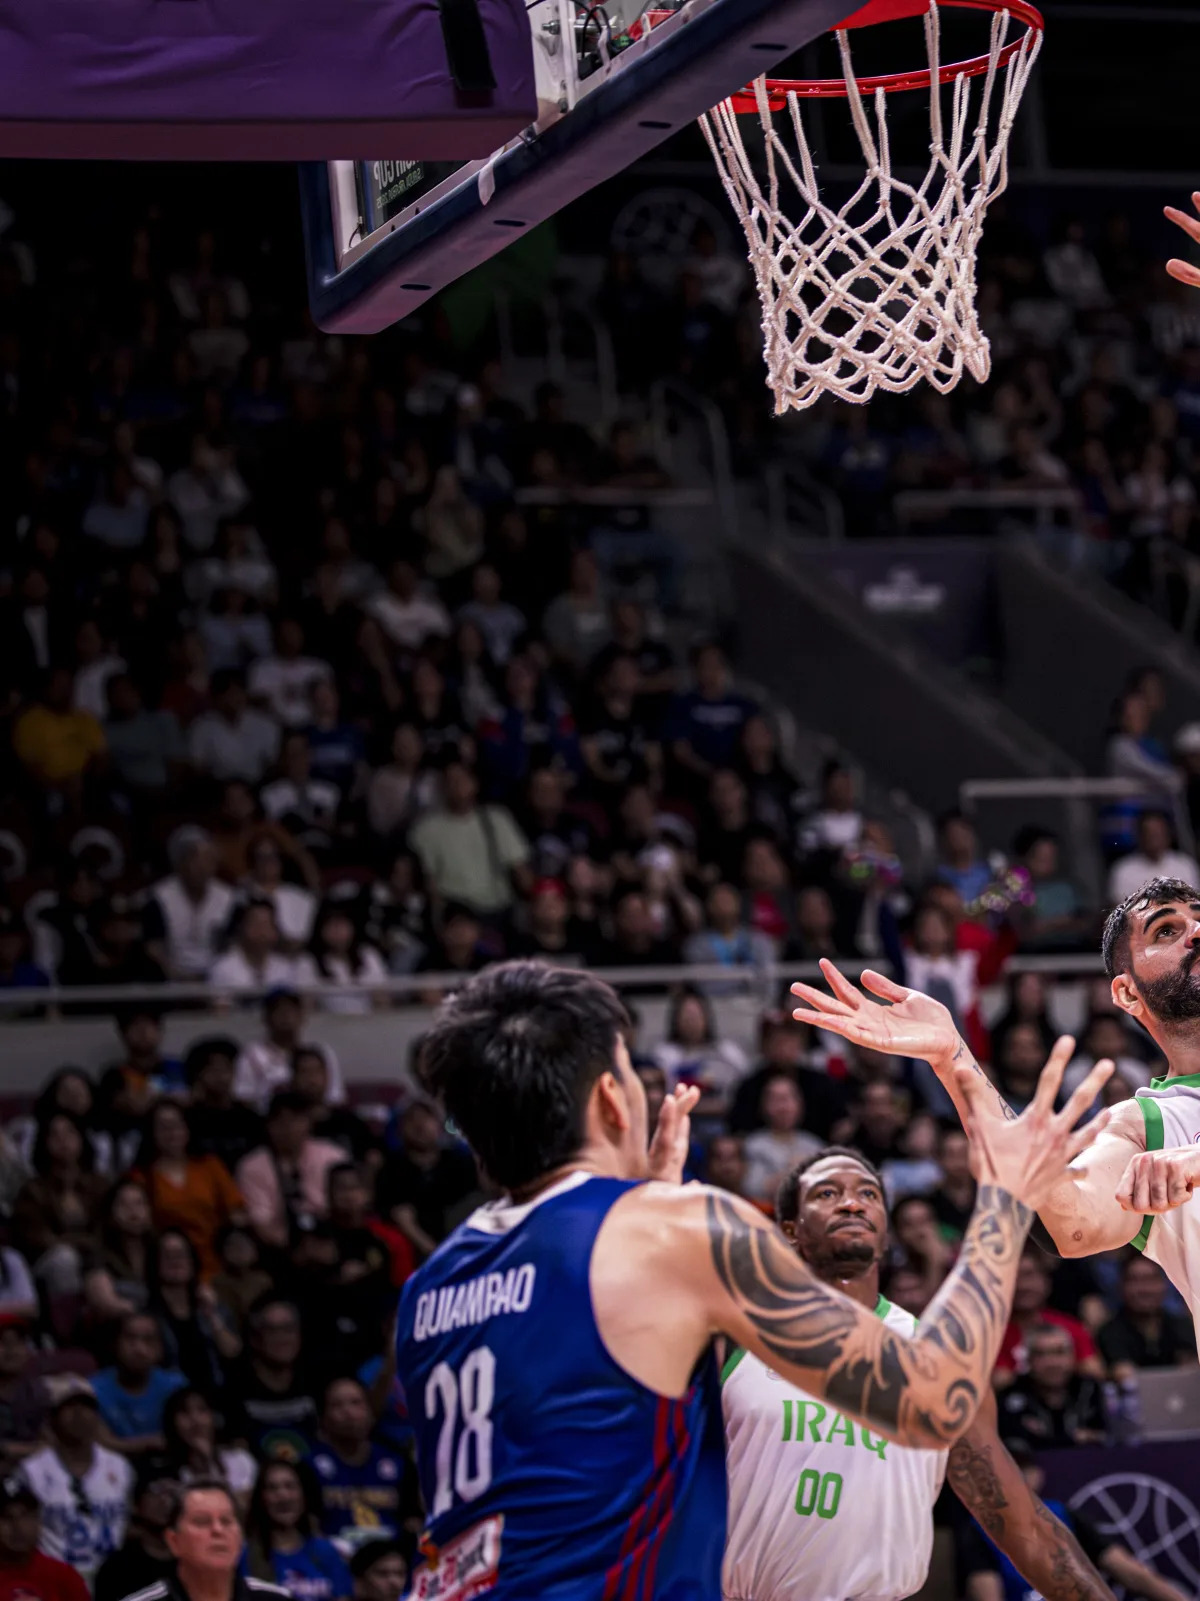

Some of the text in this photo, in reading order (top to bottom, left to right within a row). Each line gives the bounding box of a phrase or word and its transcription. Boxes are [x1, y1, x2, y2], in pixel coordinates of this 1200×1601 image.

[425, 1346, 497, 1518] 28
[782, 1400, 889, 1460] IRAQ
[794, 1468, 843, 1519] 00
